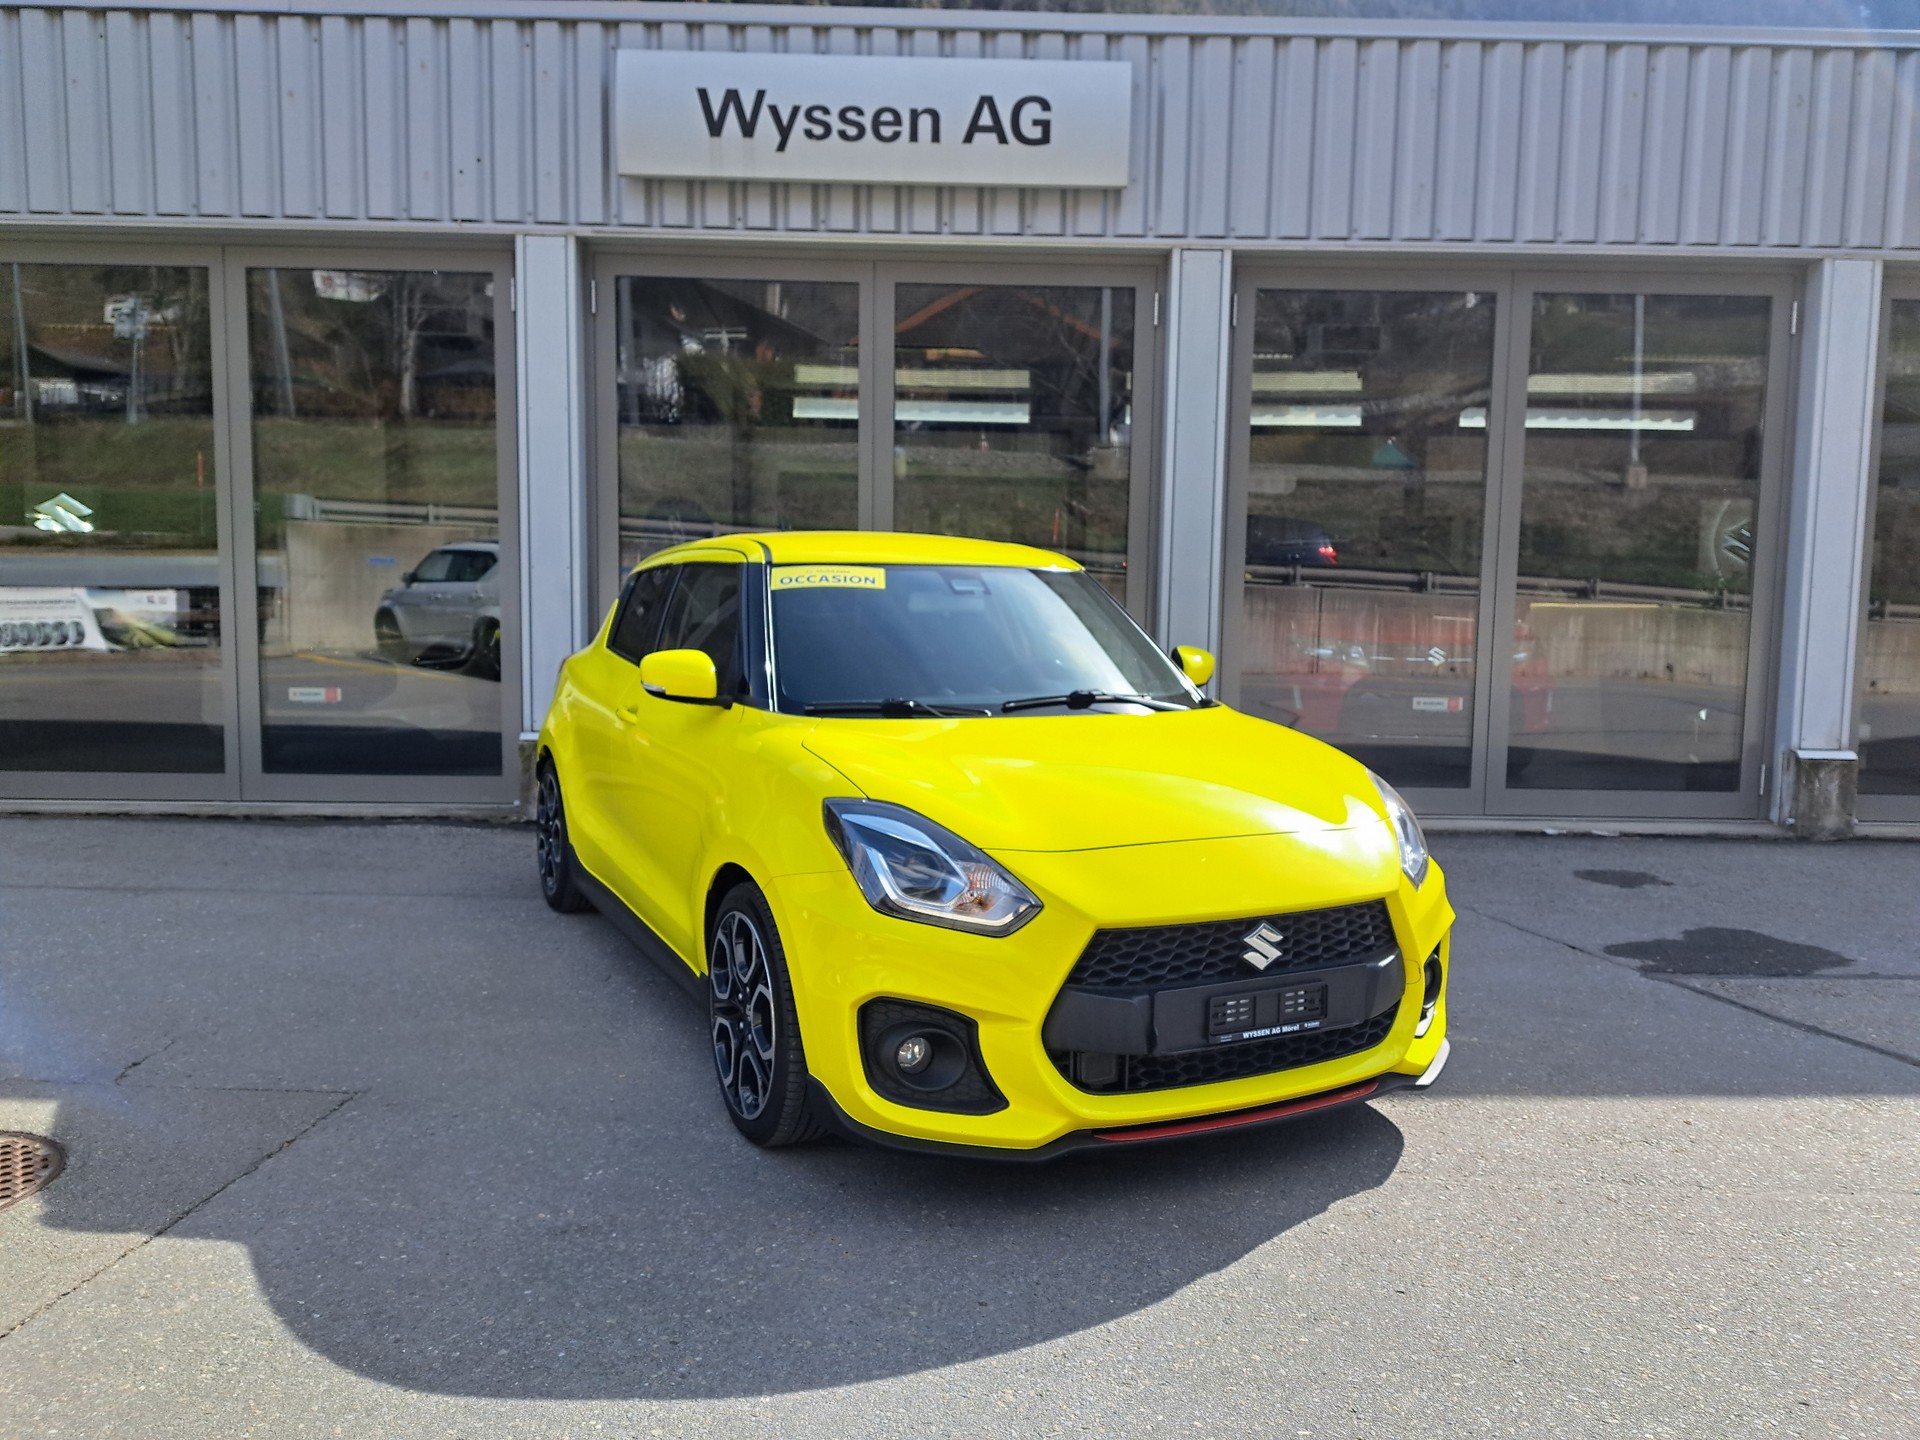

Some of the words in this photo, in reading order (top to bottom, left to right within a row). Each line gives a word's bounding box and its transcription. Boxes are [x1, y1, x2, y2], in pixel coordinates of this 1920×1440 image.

[696, 87, 941, 152] Wyssen
[961, 95, 1052, 146] AG
[780, 575, 876, 585] OCCASION
[1242, 1028, 1270, 1039] WYSSEN
[1271, 1026, 1281, 1035] AG
